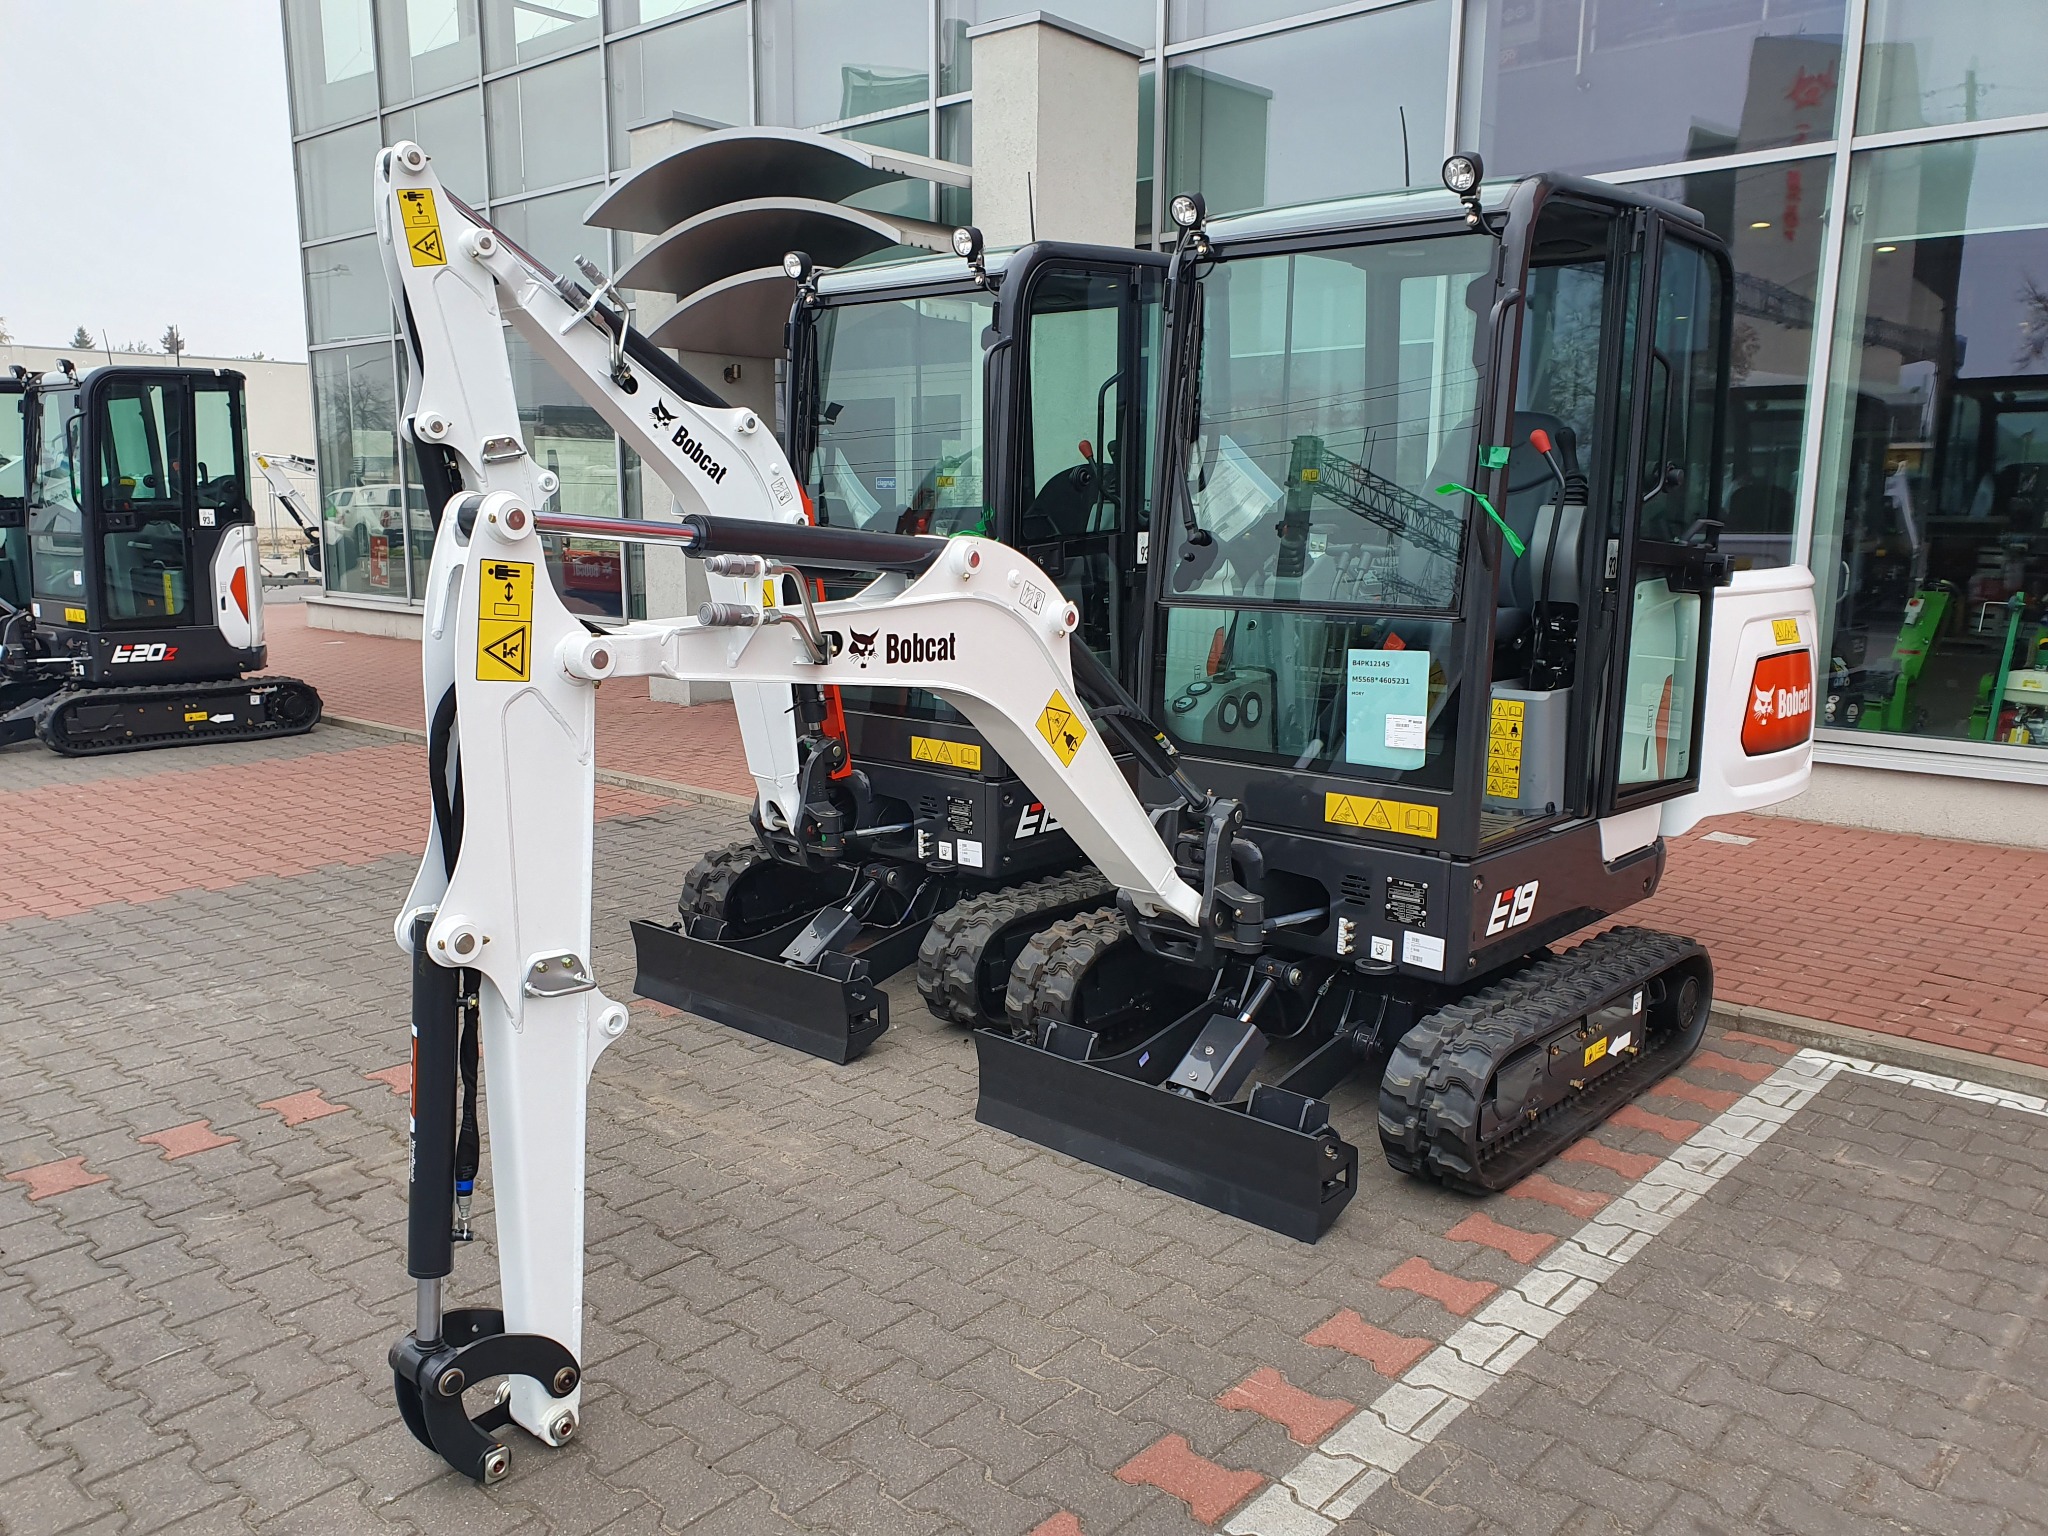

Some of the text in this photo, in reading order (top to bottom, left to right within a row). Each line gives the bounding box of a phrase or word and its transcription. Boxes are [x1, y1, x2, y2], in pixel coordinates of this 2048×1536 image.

[671, 424, 728, 485] Bobcat
[886, 632, 956, 664] Bobcat
[1777, 682, 1812, 720] Bobcat
[1485, 880, 1540, 939] E19
